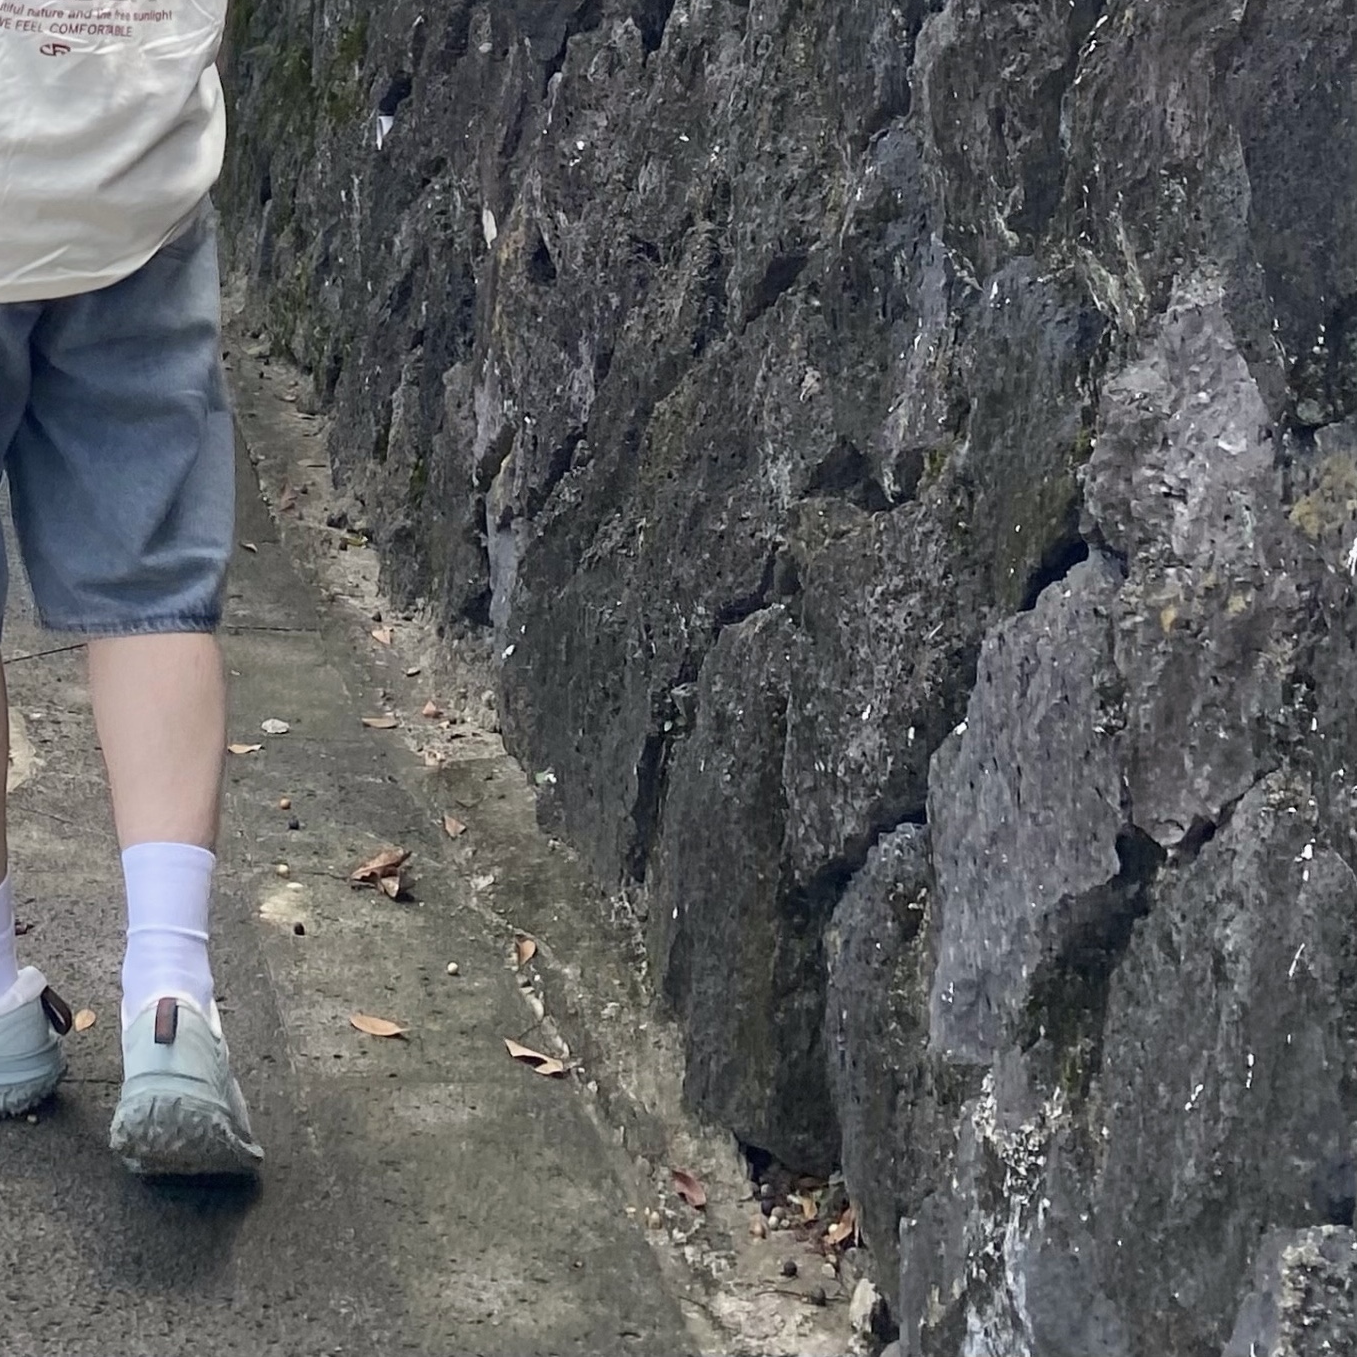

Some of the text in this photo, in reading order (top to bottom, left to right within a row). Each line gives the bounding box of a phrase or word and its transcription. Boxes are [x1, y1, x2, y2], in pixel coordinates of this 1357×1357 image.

[27, 7, 64, 18] nature
[68, 9, 93, 19] and
[133, 9, 172, 22] sunlight
[15, 19, 44, 33] FEEL
[49, 22, 133, 37] COMFORTABLE
